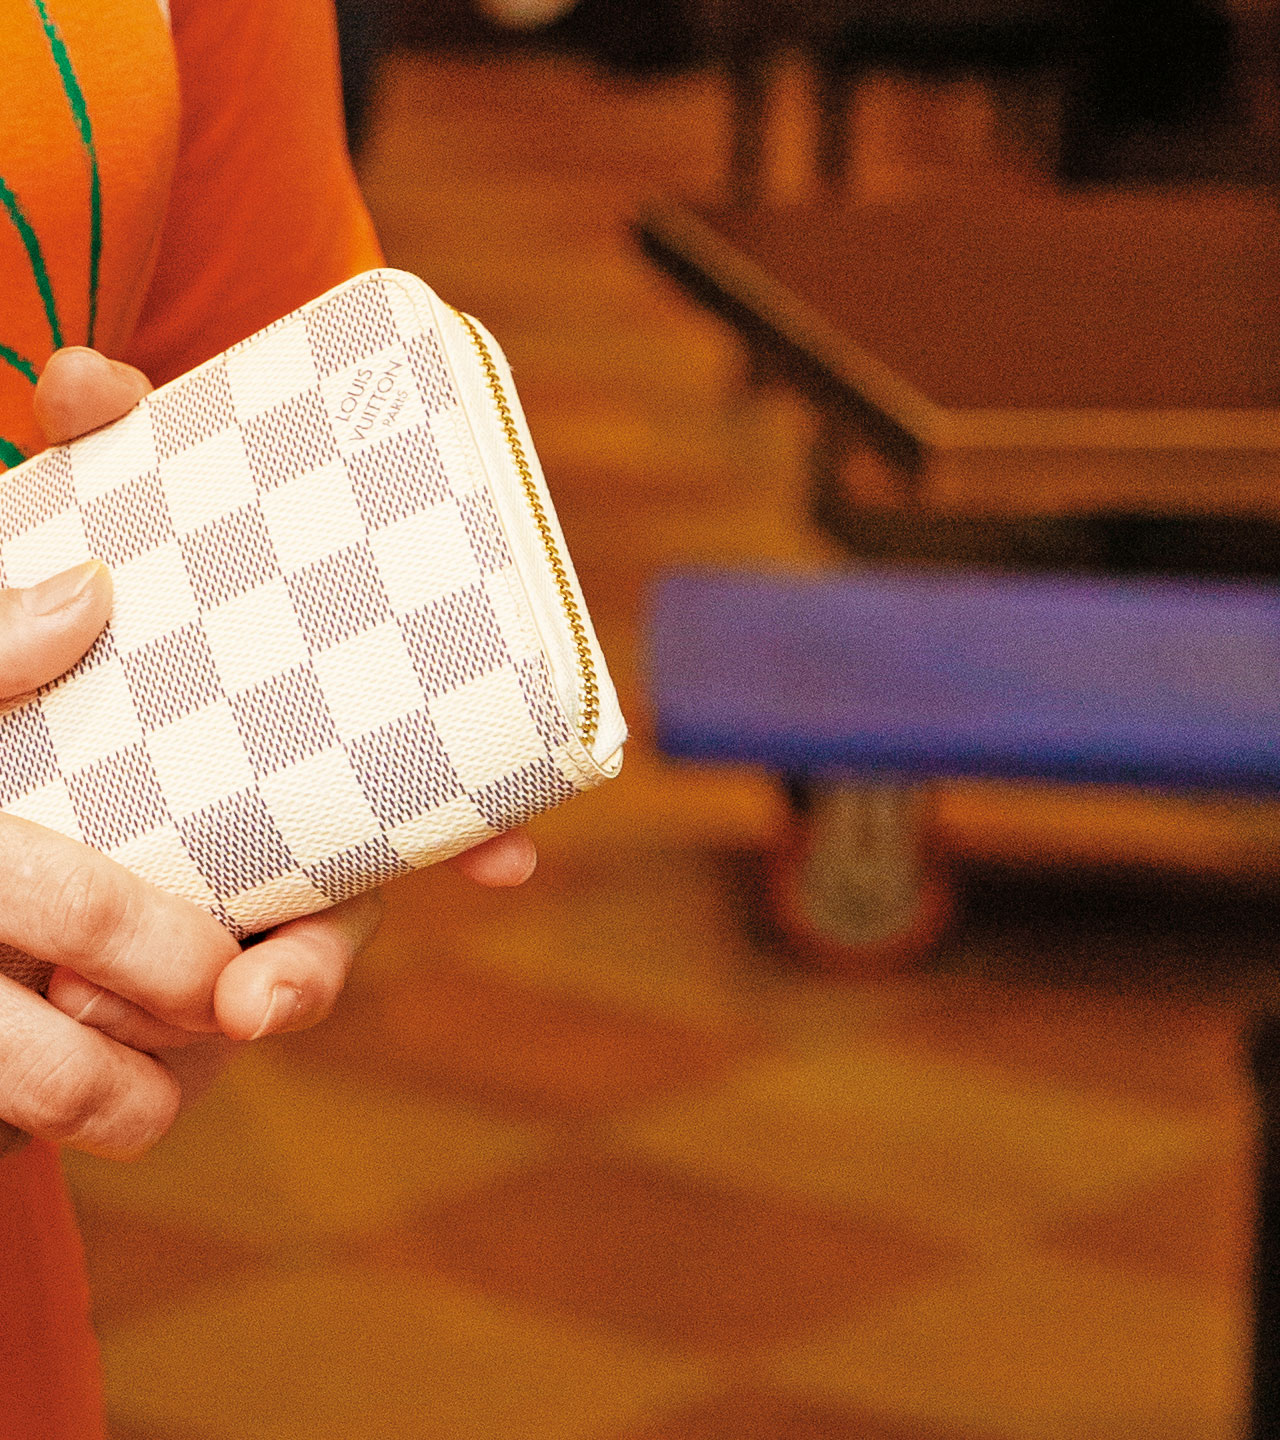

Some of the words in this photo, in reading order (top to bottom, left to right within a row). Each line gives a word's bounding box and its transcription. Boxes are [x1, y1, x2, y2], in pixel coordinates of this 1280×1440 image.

[335, 368, 373, 422] LOUIS
[348, 360, 403, 441] VUITTON
[382, 390, 408, 427] PARIS
